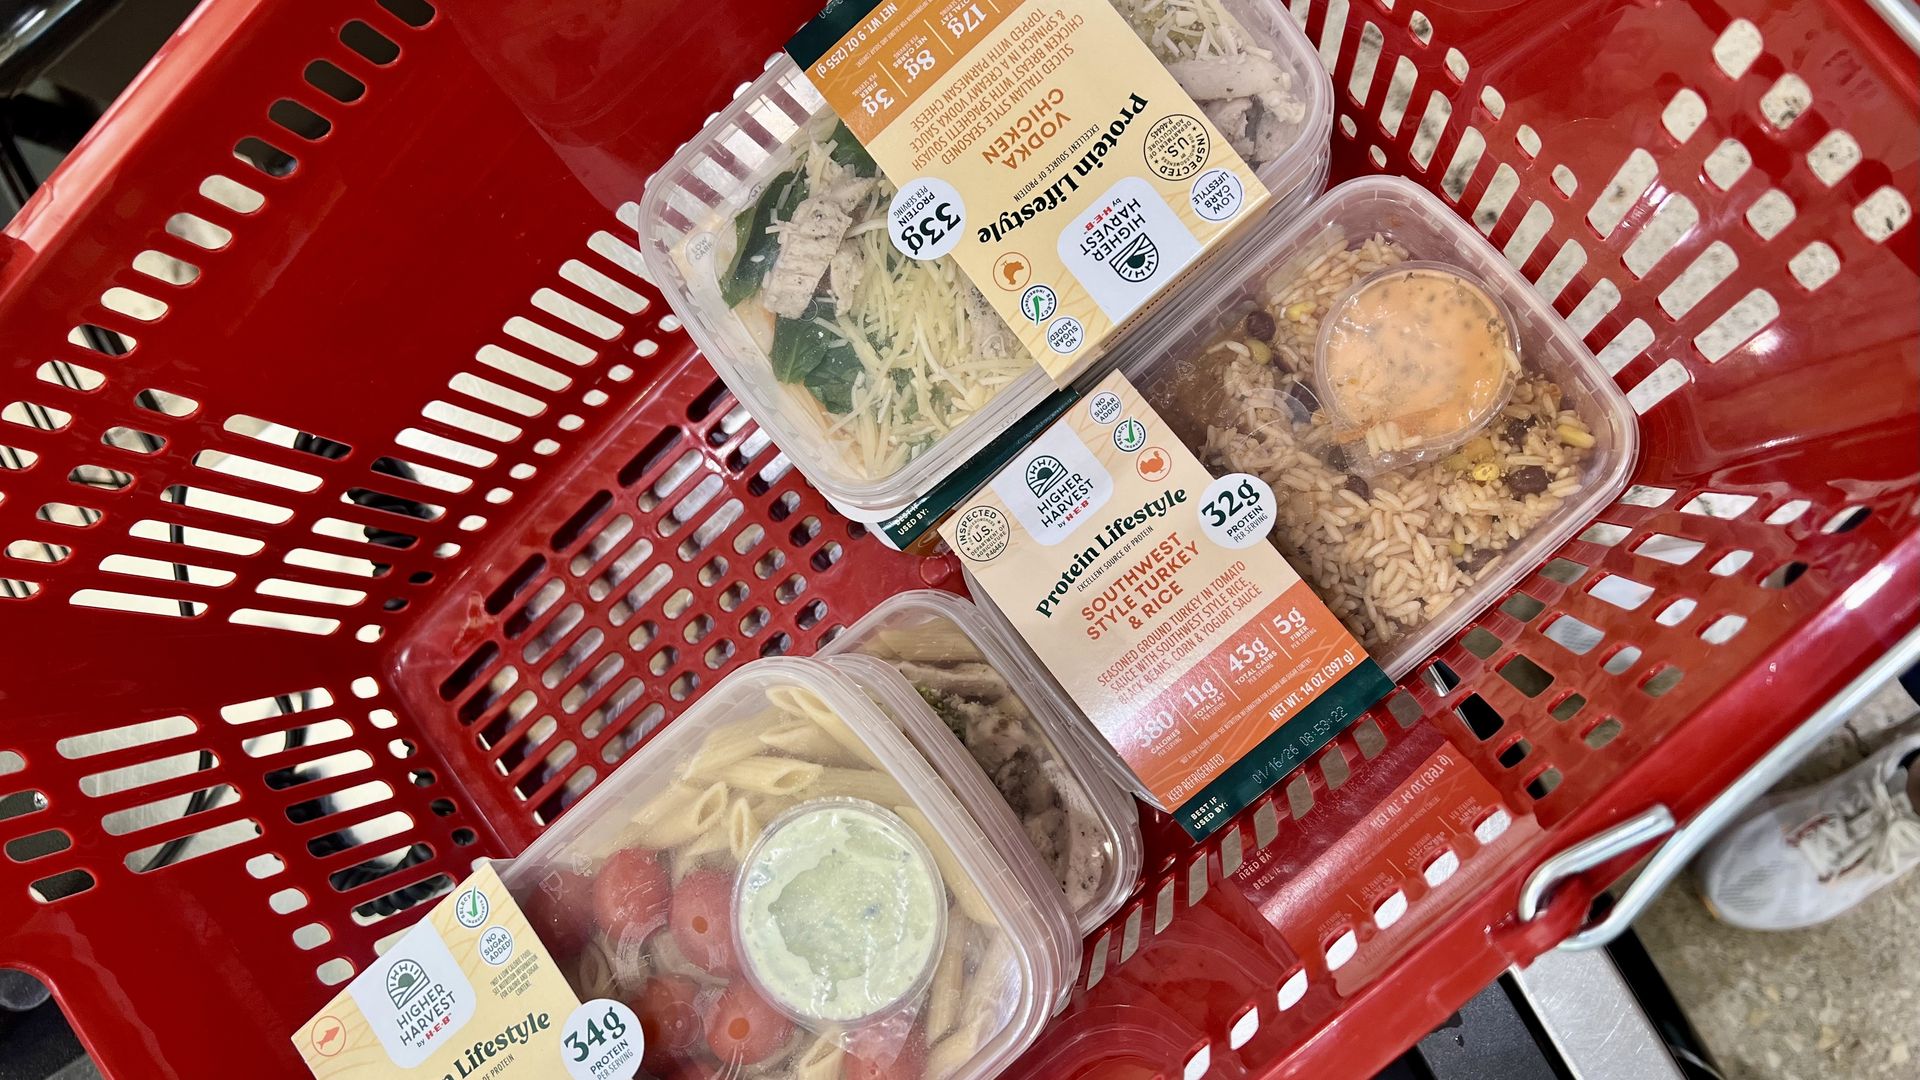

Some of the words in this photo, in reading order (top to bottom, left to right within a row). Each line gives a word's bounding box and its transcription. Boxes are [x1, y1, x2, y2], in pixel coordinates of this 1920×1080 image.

[863, 17, 882, 34] WT.
[879, 2, 898, 22] NET
[940, 11, 953, 26] FAT
[947, 0, 987, 39] 17g
[1009, 8, 1046, 42] TOPPED
[1054, 9, 1066, 20] &
[844, 37, 859, 52] OZ
[857, 30, 866, 41] 9
[914, 35, 928, 49] NET
[1018, 15, 1059, 54] SPINACH
[1042, 14, 1084, 53] CHICKEN
[825, 46, 849, 70] (255
[892, 47, 915, 69] CARBS
[986, 38, 1013, 63] WITH
[999, 58, 1010, 70] A
[1007, 48, 1022, 64] IN
[1011, 47, 1046, 82] BREAST
[1041, 42, 1074, 75] SLICED
[815, 62, 827, 79] g)
[941, 57, 990, 103] PARMESAN
[966, 66, 1003, 103] CREAMY
[859, 80, 878, 98] FIBER
[861, 88, 895, 117] 3g
[988, 76, 1015, 102] WITH
[1008, 70, 1044, 104] ITALIAN
[910, 98, 944, 132] CHEESE
[935, 97, 969, 127] VODKA
[944, 96, 992, 141] SPAGHETTI
[981, 88, 1064, 165] CHICKEN
[982, 98, 1012, 127] STYLE
[909, 122, 940, 153] SAUCE
[941, 121, 986, 165] SEASONED
[1001, 111, 1071, 169] VODKA
[1068, 123, 1100, 154] EXCELLENT
[1072, 92, 1148, 174] Protein
[1147, 118, 1184, 152] AGRICULTURE
[1157, 120, 1192, 152] DEPARTMENT
[1164, 136, 1189, 157] U.S.
[911, 135, 948, 172] SQUASH
[1045, 150, 1069, 174] SOURCE
[1149, 150, 1157, 160] OF
[1158, 132, 1205, 177] INSPECTED
[915, 185, 928, 198] PER
[1013, 178, 1039, 202] PROTEIN
[1038, 170, 1047, 181] OF
[1191, 171, 1229, 205] LIFESTYLE
[893, 194, 917, 219] SERVING
[897, 191, 935, 227] PROTEIN
[976, 171, 1078, 242] Lifestyle
[1112, 197, 1122, 207] by
[1204, 184, 1230, 208] CARB
[1212, 192, 1235, 214] LOW
[901, 202, 961, 255] 33g
[1079, 197, 1141, 256] HARVEST
[1091, 213, 1146, 261] HIGHER
[1053, 325, 1078, 347] SUGAR
[1065, 336, 1077, 347] NO
[1093, 397, 1116, 418] SUGAR
[1095, 397, 1106, 408] NO
[1036, 473, 1083, 515] HIGHER
[1041, 478, 1094, 528] HARVEST
[1201, 478, 1260, 527] 32g
[897, 518, 917, 535] USED
[915, 508, 929, 520] BY:
[959, 509, 996, 544] INSPECTED
[972, 525, 993, 543] U.S.
[1057, 520, 1066, 528] by
[1226, 504, 1263, 537] PROTEIN
[1233, 529, 1246, 543] PER
[1244, 512, 1268, 534] SERVING
[970, 529, 999, 556] DEPARTMENT
[998, 523, 1005, 532] OF
[976, 530, 1007, 558] AGRICULTURE
[1035, 546, 1100, 617] Protein
[1094, 489, 1187, 550] Lifestyle
[1076, 566, 1105, 592] EXCELLENT
[1102, 549, 1125, 570] SOURCE
[1122, 543, 1131, 553] OF
[1130, 525, 1154, 547] PROTEIN
[1081, 531, 1181, 621] SOUTHWEST
[1086, 594, 1138, 640] STYLE
[1133, 540, 1199, 598] TURKEY
[1128, 615, 1144, 630] &
[1140, 580, 1183, 619] RICE
[1272, 606, 1306, 634] 5g
[1097, 649, 1139, 687] SEASONED
[1136, 621, 1172, 653] GROUND
[1168, 594, 1203, 626] TURKEY
[1200, 586, 1214, 601] IN
[1209, 560, 1245, 592] TOMATO
[1289, 625, 1309, 641] FIBER
[1110, 667, 1139, 693] SAUCE
[1134, 650, 1159, 673] WITH
[1155, 611, 1204, 656] SOUTHWEST
[1201, 592, 1229, 618] STYLE
[1117, 678, 1147, 705] BLACK
[1171, 637, 1197, 661] CORN
[1193, 632, 1204, 643] &
[1199, 605, 1235, 636] YOGURT
[1232, 583, 1262, 611] SAUCE
[1229, 636, 1269, 679] 43g
[1234, 667, 1257, 685] TOTAL
[1255, 650, 1277, 669] CARBS
[1181, 677, 1221, 713] 11g
[1268, 702, 1288, 721] NET
[1283, 692, 1303, 708] WT.
[1300, 682, 1314, 695] 14
[1310, 672, 1326, 687] OZ
[1321, 657, 1344, 679] (397
[1342, 649, 1355, 665] g)
[1192, 702, 1214, 719] TOTAL
[1212, 691, 1225, 704] FAT
[1131, 707, 1177, 751] 380
[1150, 728, 1182, 754] CALORIES
[1251, 743, 1299, 784] 01/16/26
[1298, 705, 1348, 747] 08:53:22
[1166, 784, 1184, 803] KEEP
[1180, 753, 1225, 791] REFRIGERATED
[1190, 802, 1209, 820] BEST
[1208, 796, 1217, 806] IF
[1193, 812, 1215, 829] USED
[1214, 802, 1228, 813] BY:
[483, 933, 508, 956] SUGAR
[485, 932, 497, 944] NO
[396, 983, 445, 1030] HIGHER
[399, 990, 455, 1046] HARVEST
[416, 1038, 425, 1048] by
[453, 1011, 551, 1078] Lifestyle
[563, 1006, 626, 1062] 34g
[489, 1053, 514, 1077] PROTEIN
[589, 1038, 629, 1075] PROTEIN
[595, 1067, 611, 1080] PER
[605, 1048, 634, 1073] SERVING
